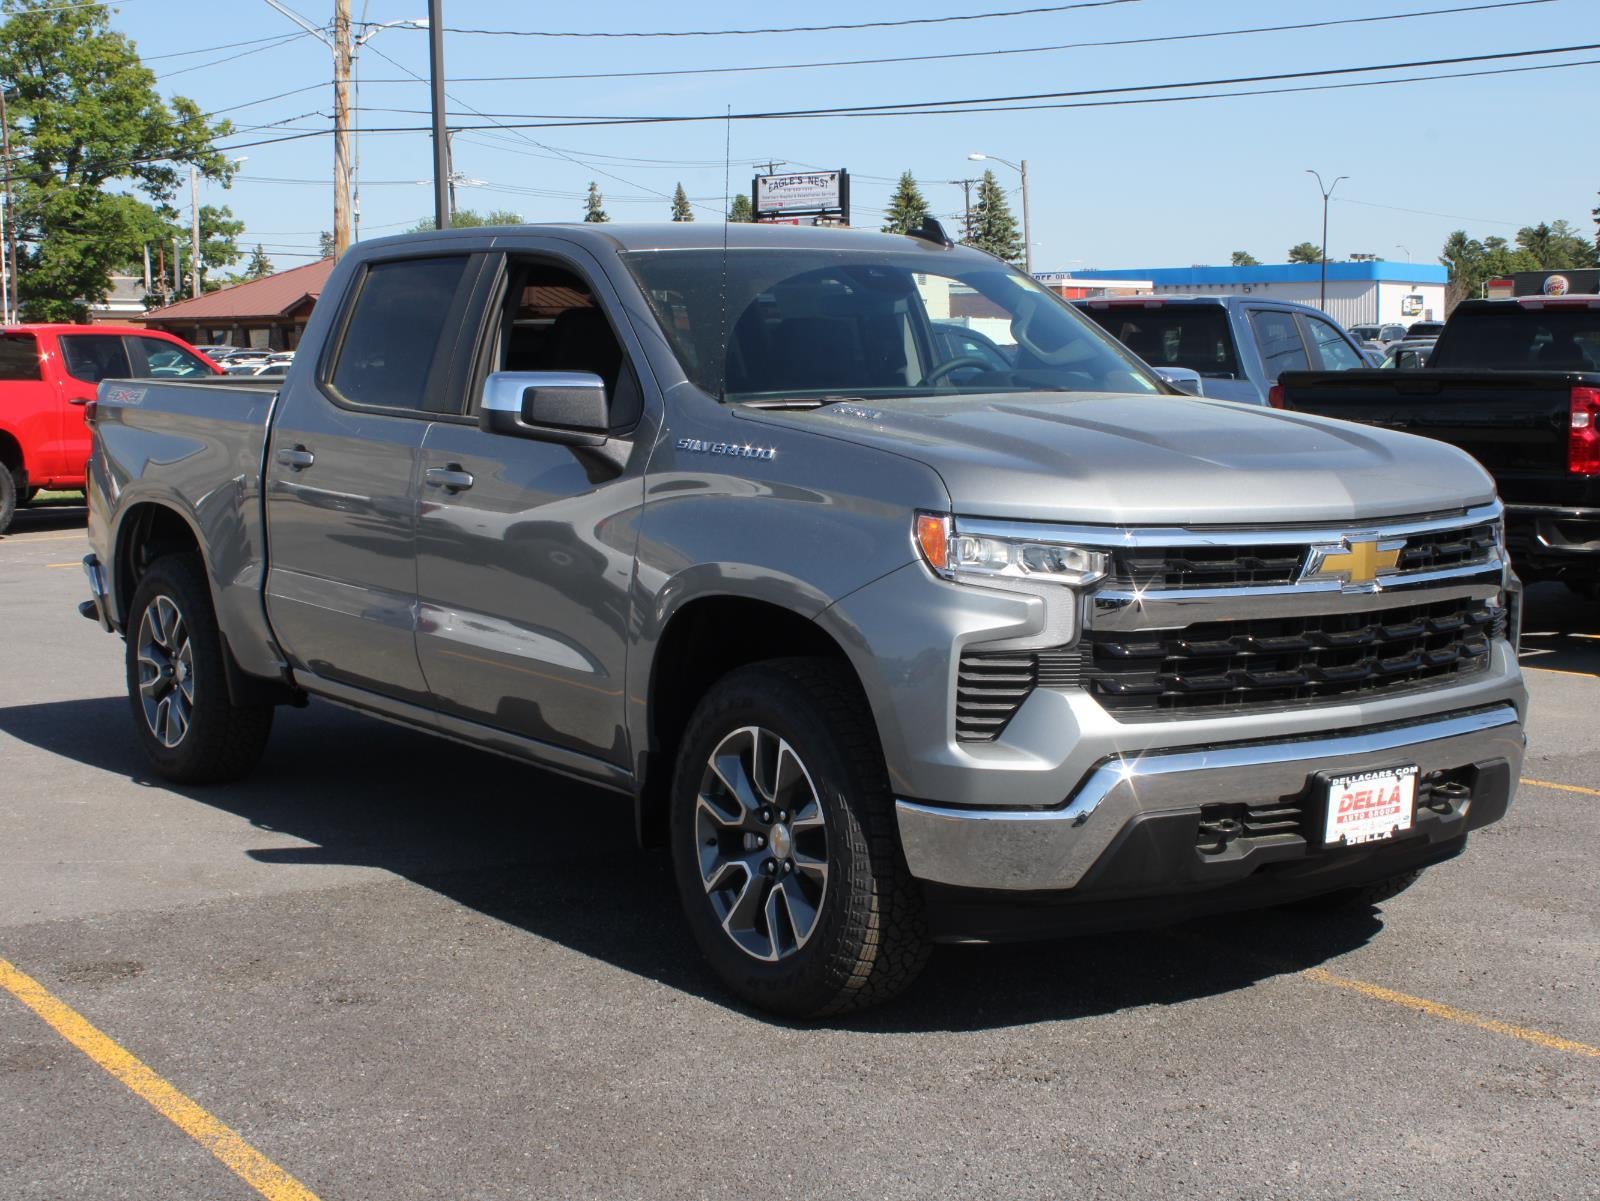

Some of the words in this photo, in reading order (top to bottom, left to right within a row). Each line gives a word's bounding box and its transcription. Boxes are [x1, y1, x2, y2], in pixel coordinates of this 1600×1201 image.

[768, 176, 803, 193] EAGLE'S
[808, 175, 829, 189] NEST
[1547, 283, 1564, 292] KING
[676, 437, 777, 461] SILVERADO
[1332, 765, 1419, 786] DELLACARS.COM
[1338, 785, 1401, 814] DELLA
[1342, 813, 1365, 824] AUTO
[1368, 807, 1396, 819] GROUP
[1346, 831, 1393, 846] DELLA
